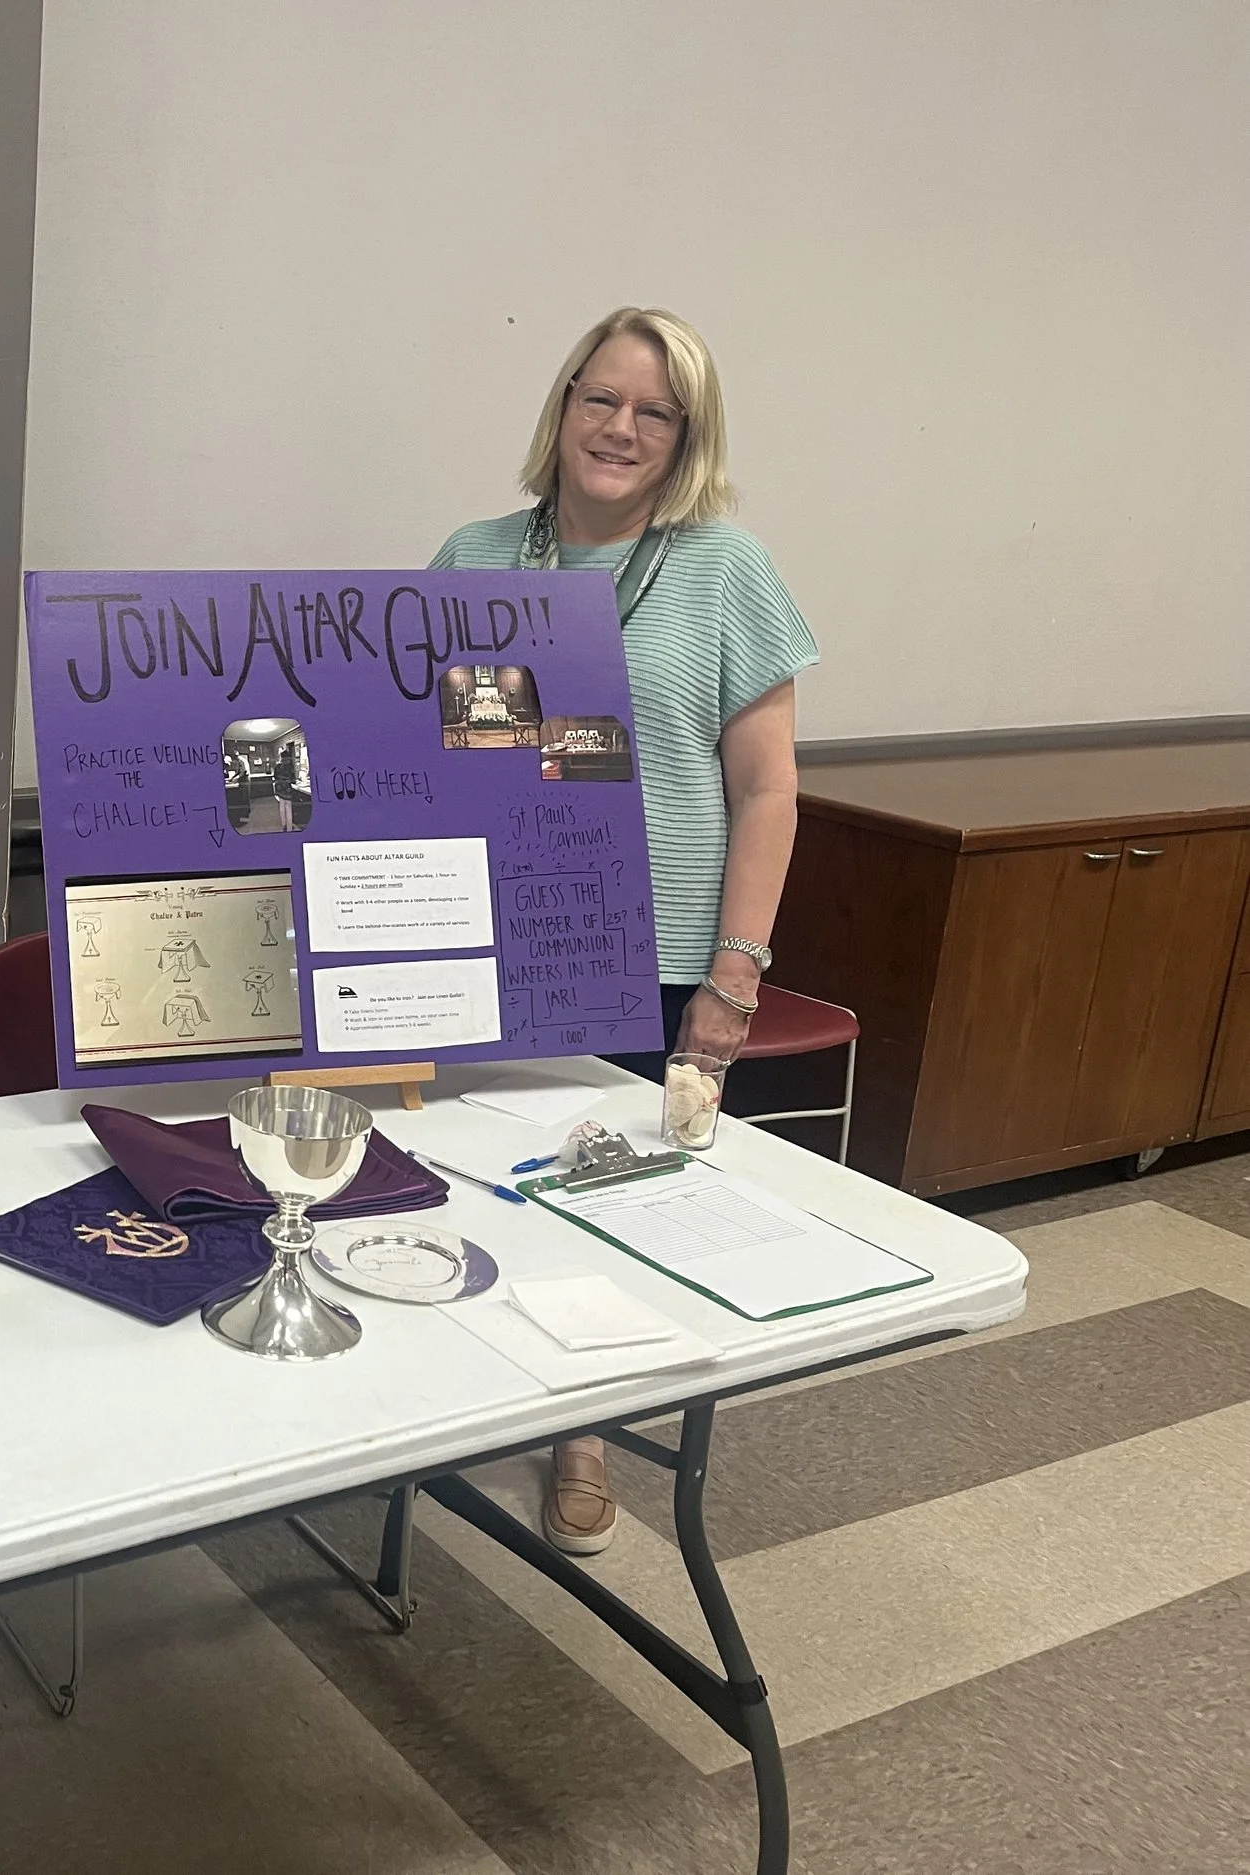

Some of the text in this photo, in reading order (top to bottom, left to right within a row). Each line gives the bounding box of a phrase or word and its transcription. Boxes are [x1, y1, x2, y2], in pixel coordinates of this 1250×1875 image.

[46, 593, 224, 703] JOIN
[384, 586, 554, 700] GUILD!!
[63, 743, 219, 774] PRACTICE VEILING
[115, 772, 144, 789] THE
[376, 768, 433, 804] HERE!
[73, 801, 188, 838] CHALICE!
[509, 806, 526, 840] St
[515, 882, 601, 912] GUESS THE
[509, 913, 599, 940] NUMBER OF
[606, 909, 628, 925] 25?
[529, 934, 614, 959] COMMUNION
[507, 958, 621, 985] WAFERS IN THE
[544, 986, 578, 1019] JAR!
